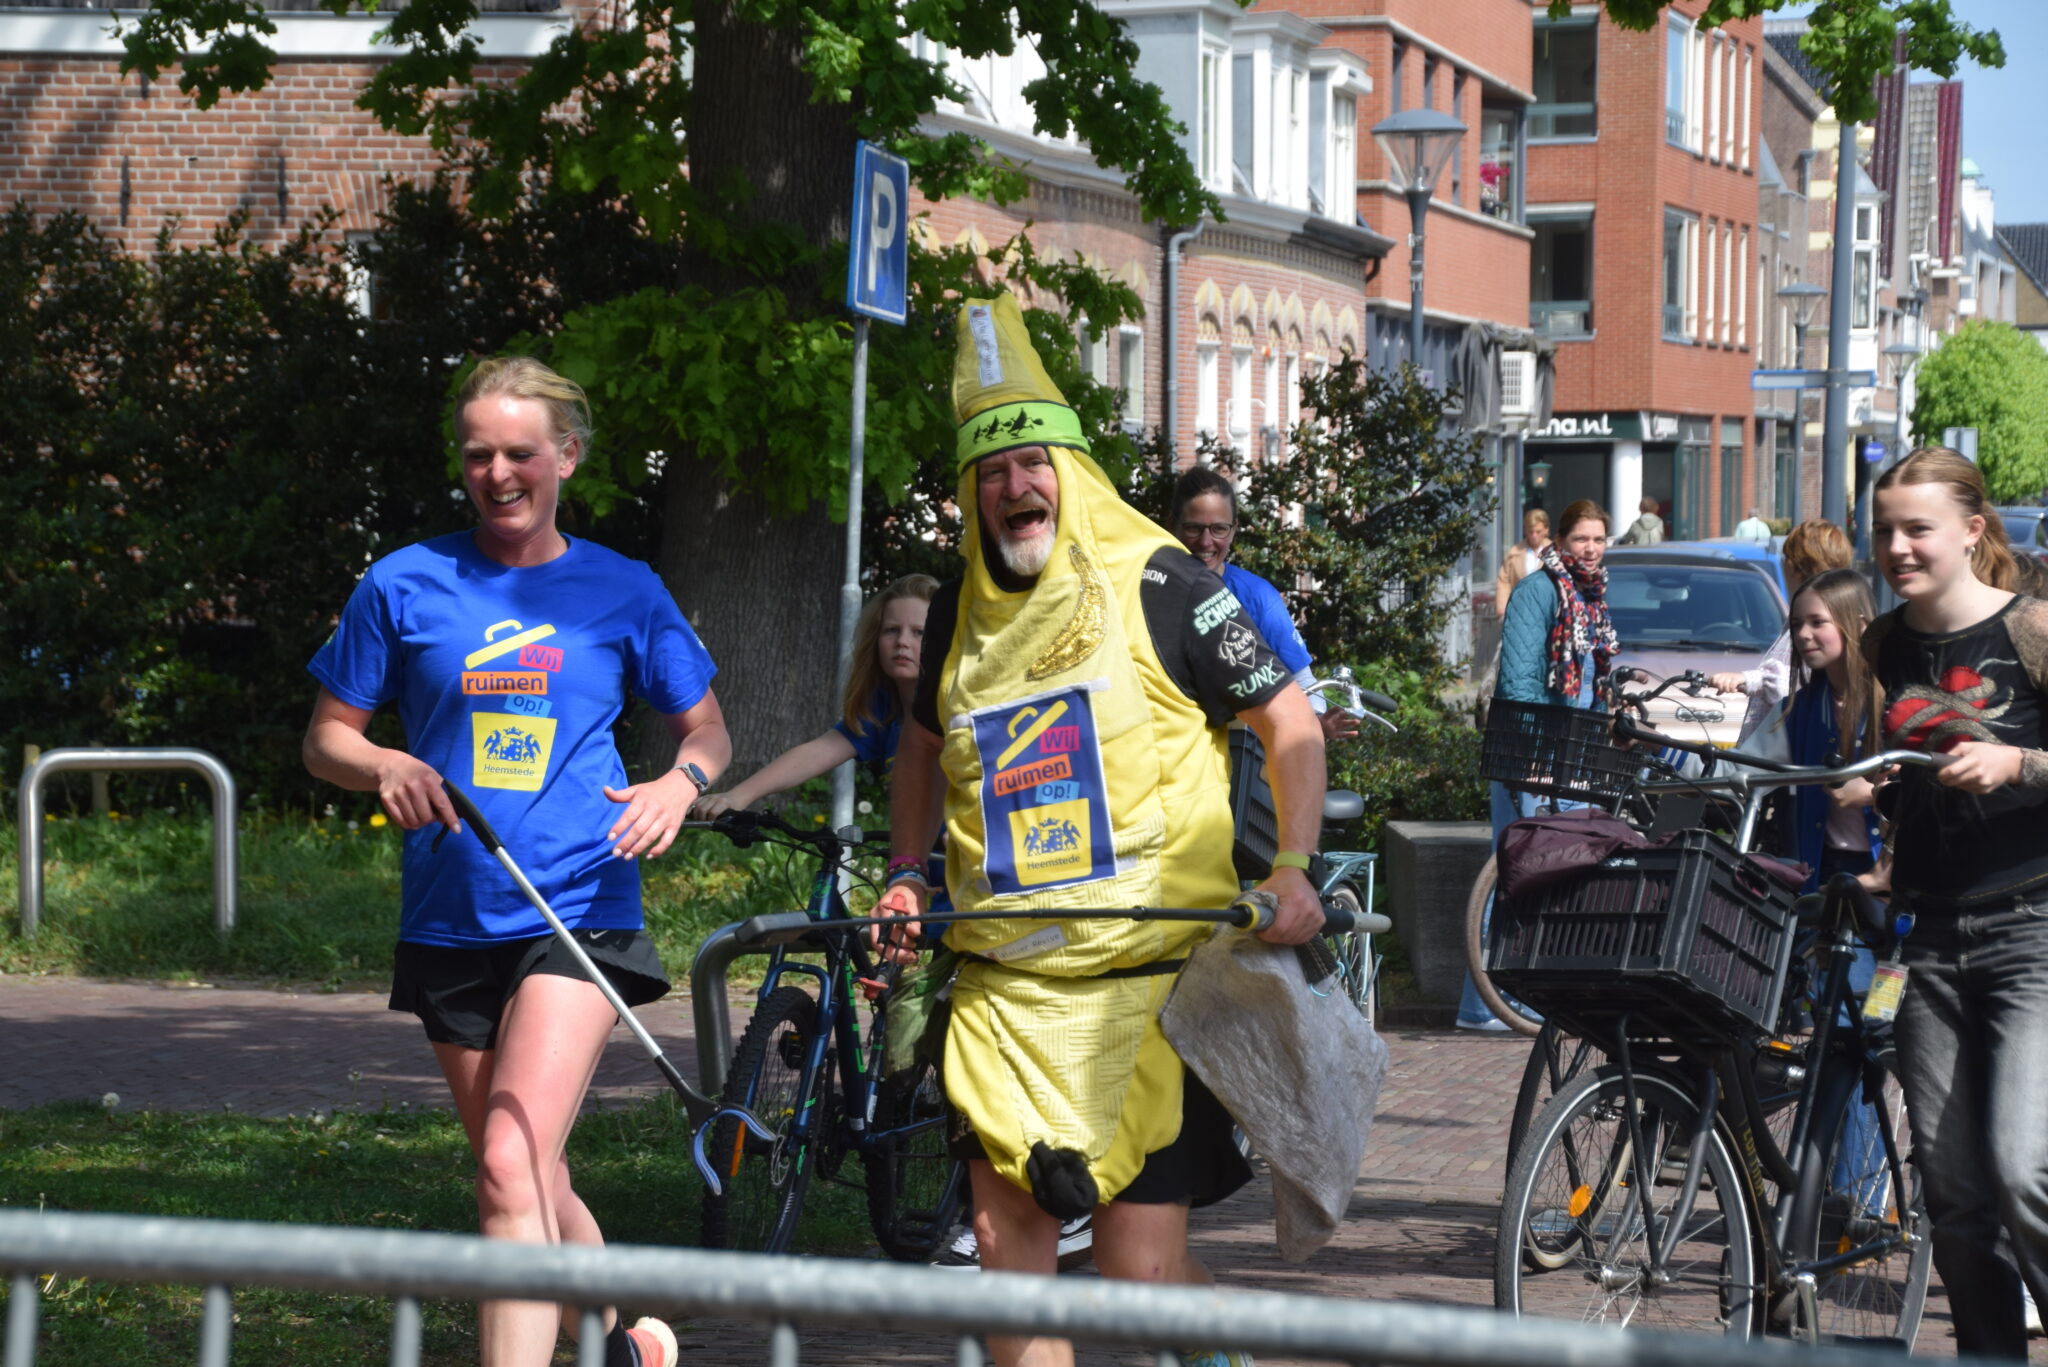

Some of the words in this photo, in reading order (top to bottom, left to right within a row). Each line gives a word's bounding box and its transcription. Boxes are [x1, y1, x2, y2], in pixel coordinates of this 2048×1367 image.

[867, 171, 897, 292] P
[524, 646, 560, 670] Wij
[466, 673, 543, 691] ruimen
[1228, 657, 1285, 698] RUNX
[513, 694, 544, 715] op!
[1043, 729, 1076, 750] Wij
[483, 763, 535, 777] Heemstede
[997, 760, 1067, 792] ruimen
[1042, 783, 1071, 800] op!
[1027, 854, 1081, 870] Heemstede
